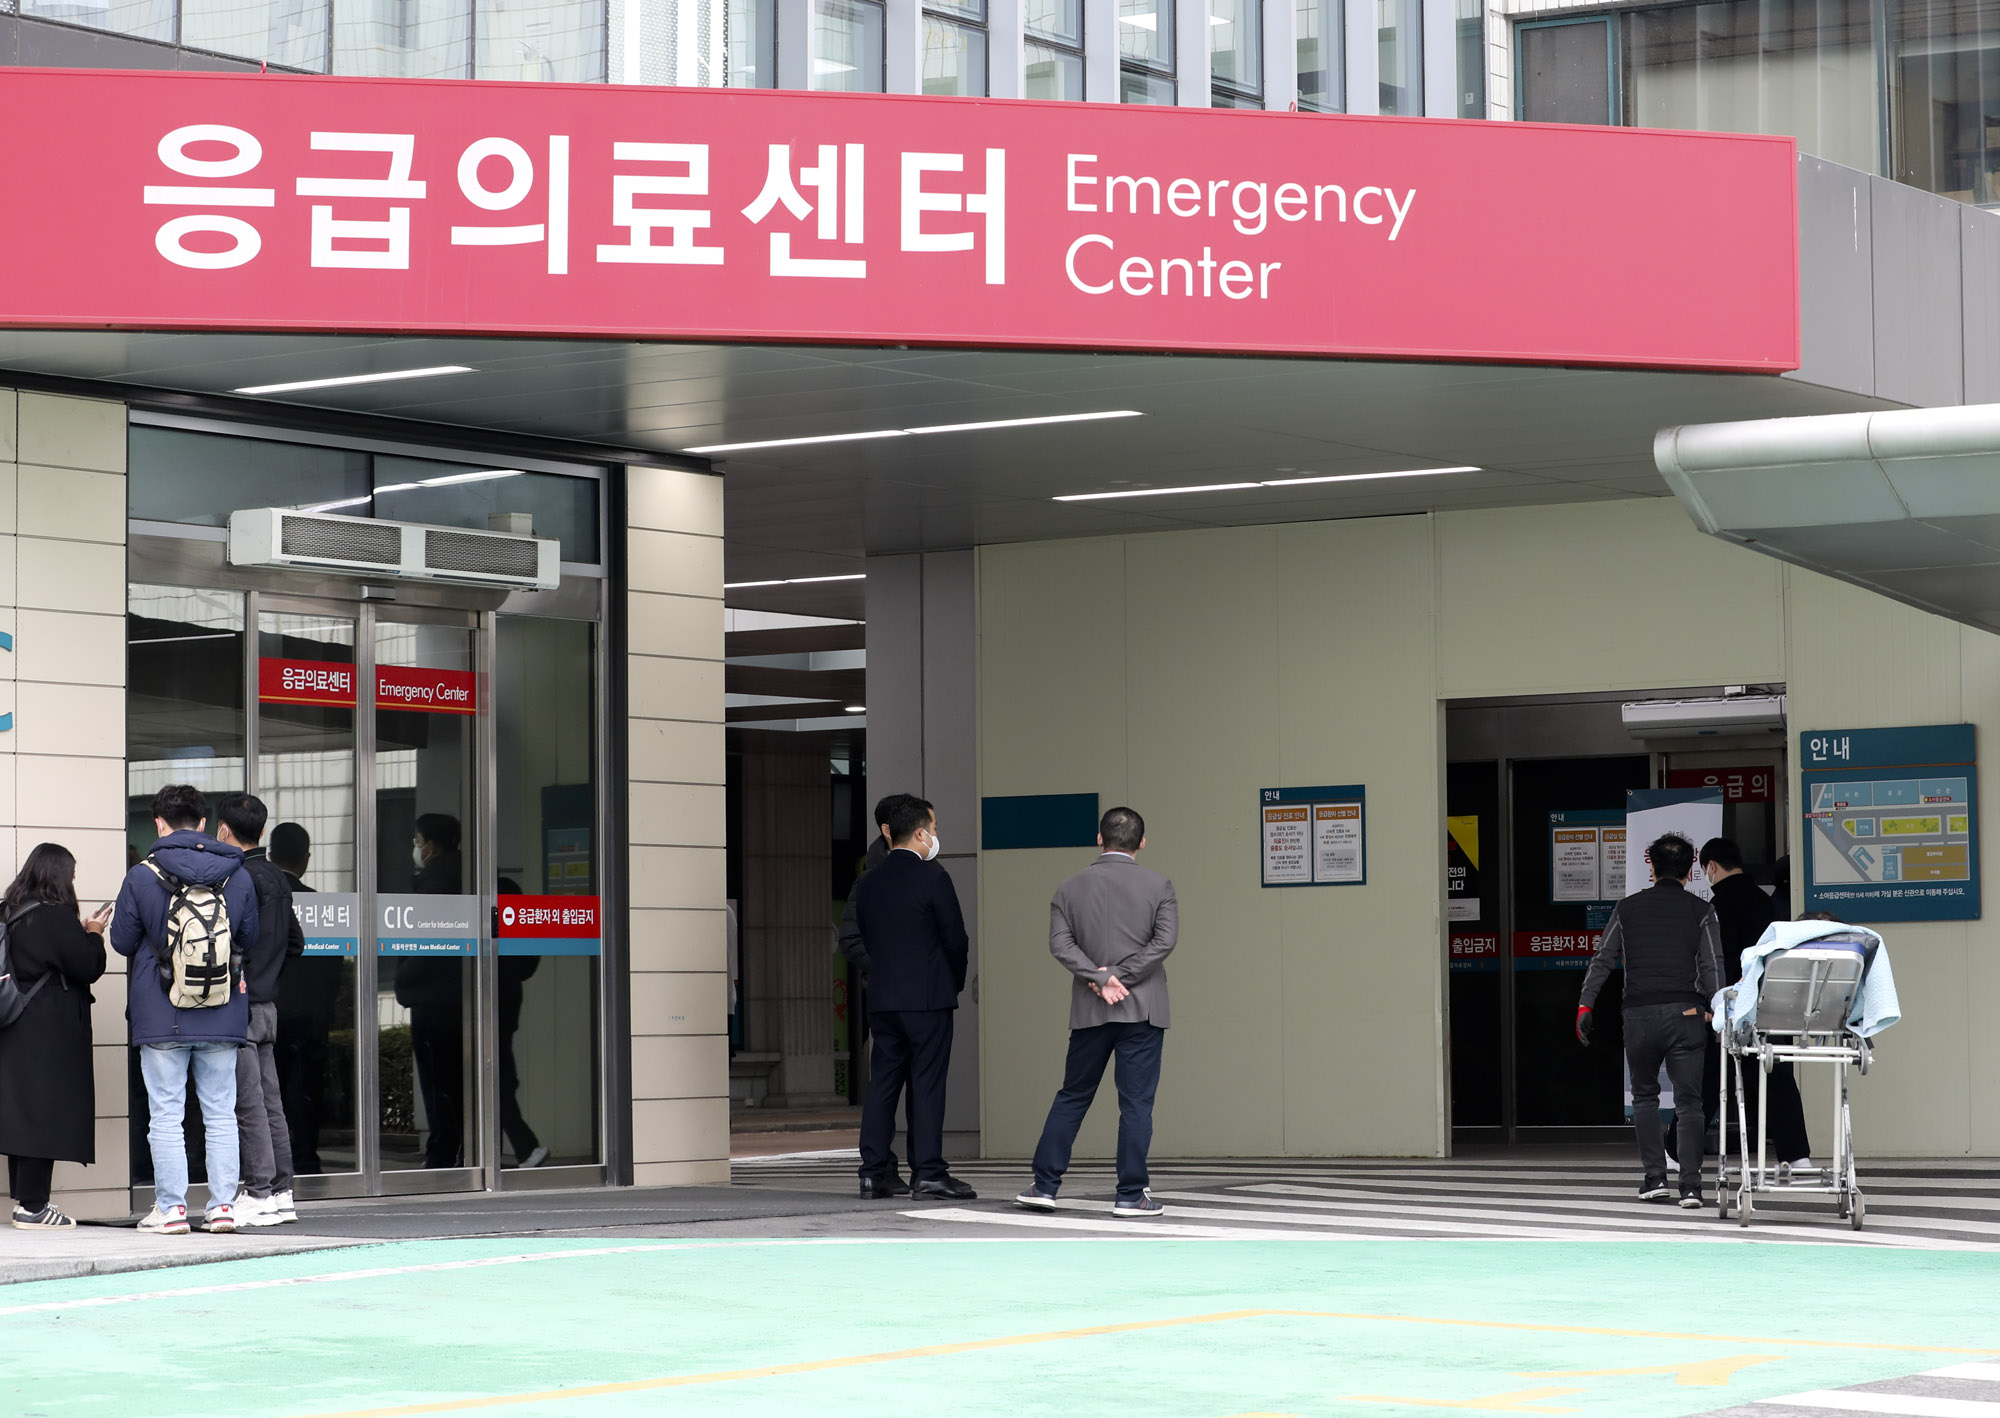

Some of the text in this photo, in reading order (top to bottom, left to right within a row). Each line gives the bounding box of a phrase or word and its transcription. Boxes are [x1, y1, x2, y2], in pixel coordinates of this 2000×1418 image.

[144, 124, 1005, 285] 응급의료센터
[1067, 153, 1416, 242] Emergency
[1065, 235, 1281, 300] Center
[282, 667, 351, 694] 응급의료센터
[380, 679, 470, 703] Emergency Center
[1810, 736, 1850, 761] 안내
[1264, 790, 1280, 801] 안내
[1550, 813, 1565, 823] 안내
[384, 906, 414, 929] CIC
[417, 920, 431, 929] Center
[437, 920, 454, 929] Infection
[454, 920, 469, 929] Control
[518, 908, 594, 925] 응급환자 외 출입금지
[1452, 937, 1495, 954] 출입금지
[1530, 936, 1575, 952] 응급환자
[1577, 936, 1588, 951] 외
